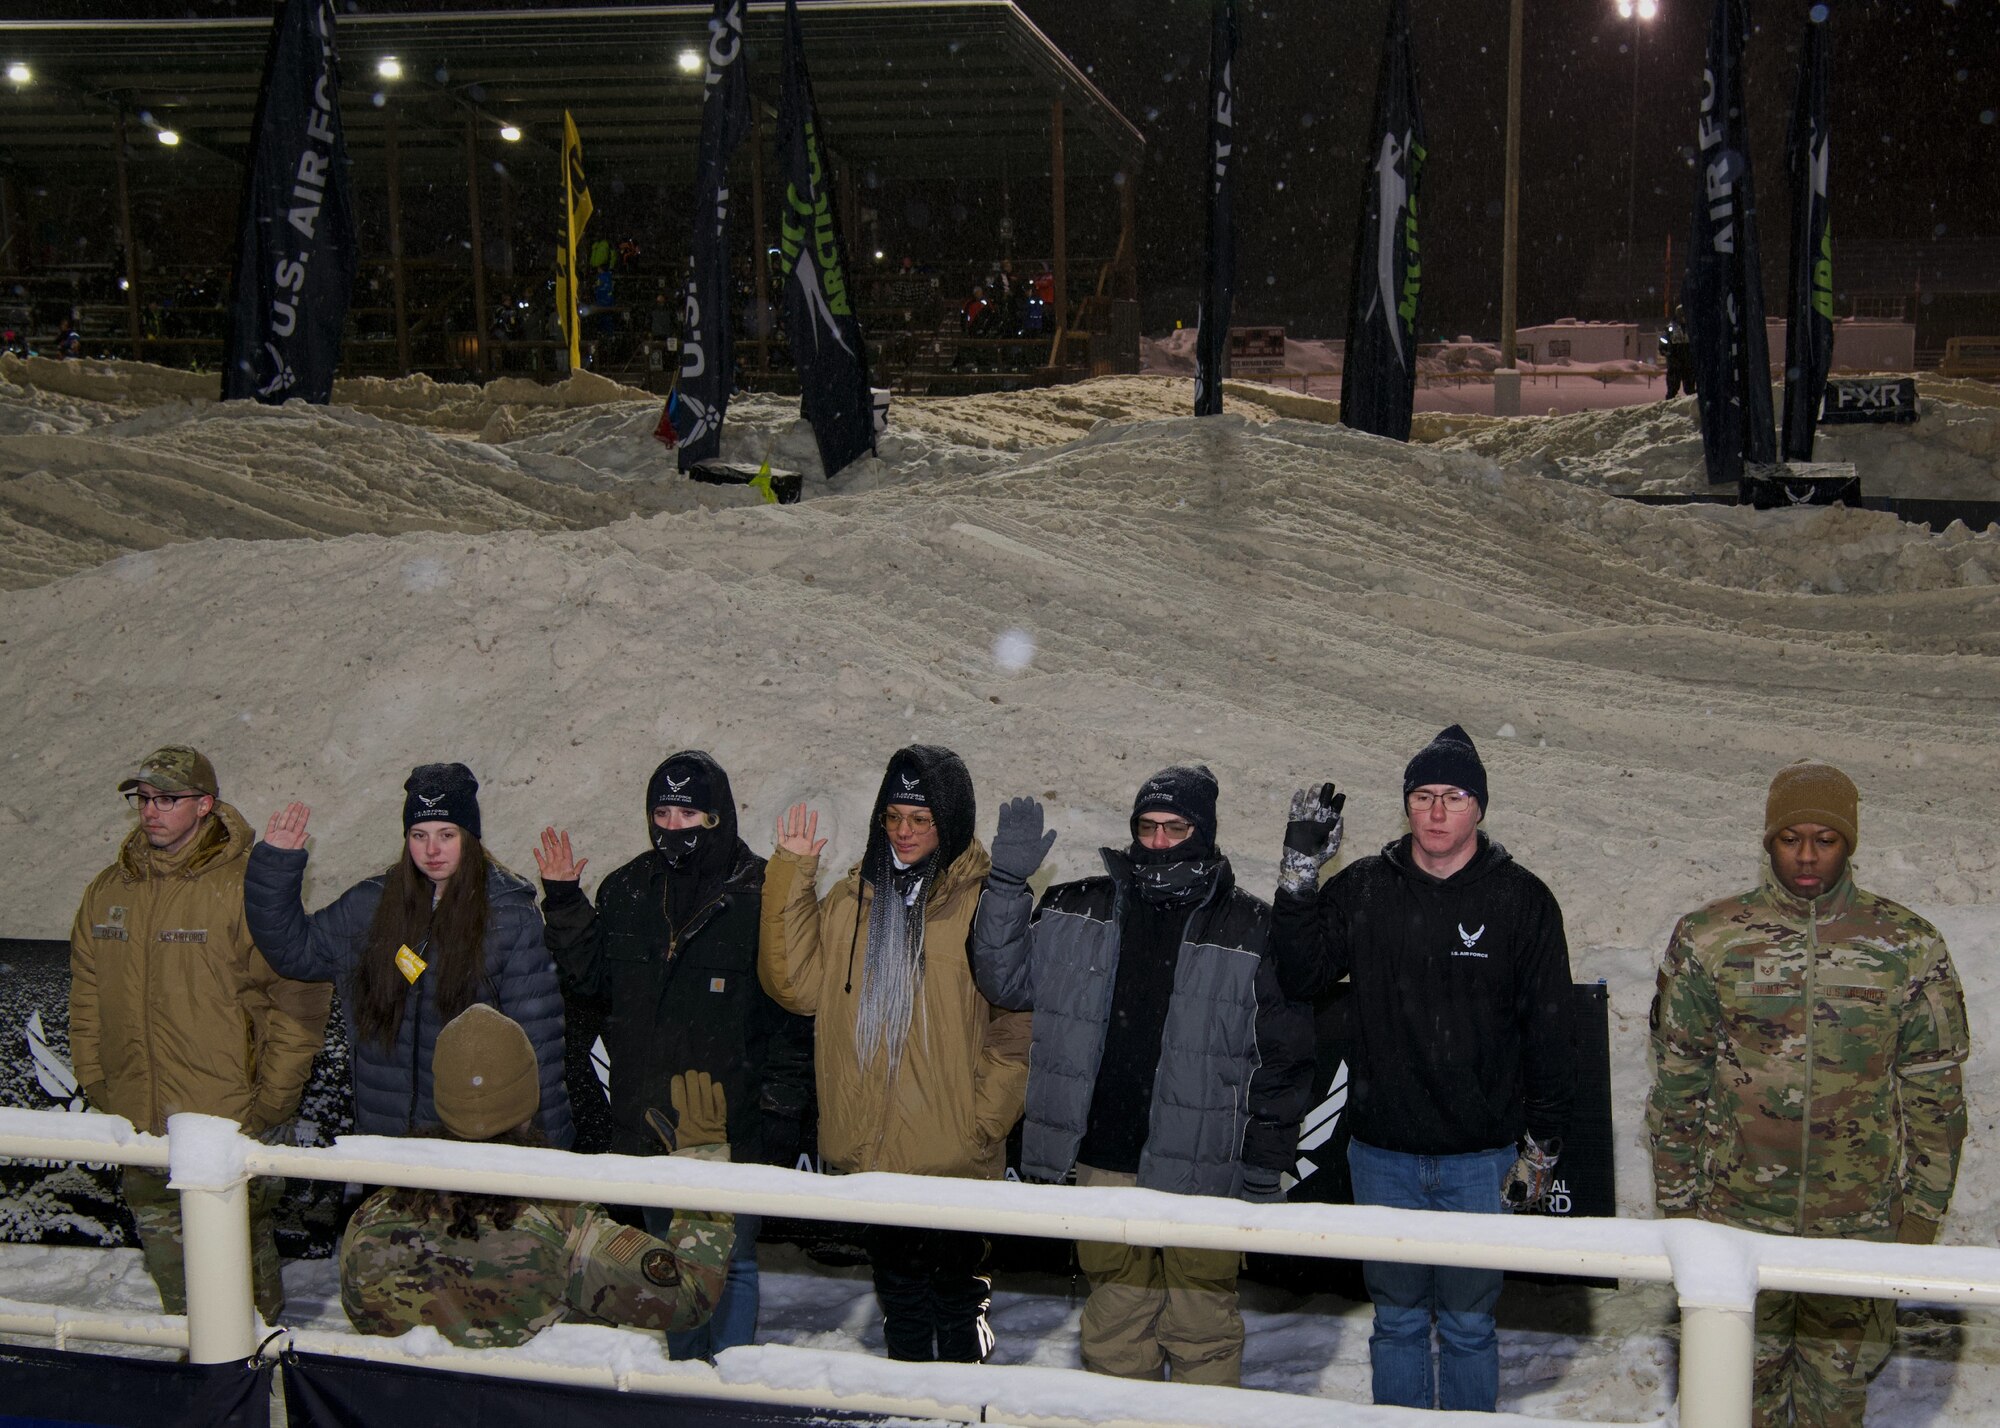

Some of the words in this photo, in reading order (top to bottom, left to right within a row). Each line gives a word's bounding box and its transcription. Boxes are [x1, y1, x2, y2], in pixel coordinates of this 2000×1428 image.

[287, 150, 330, 240] AIR
[1706, 157, 1734, 254] AIR
[272, 251, 309, 337] U.S.
[1838, 384, 1900, 408] FXR
